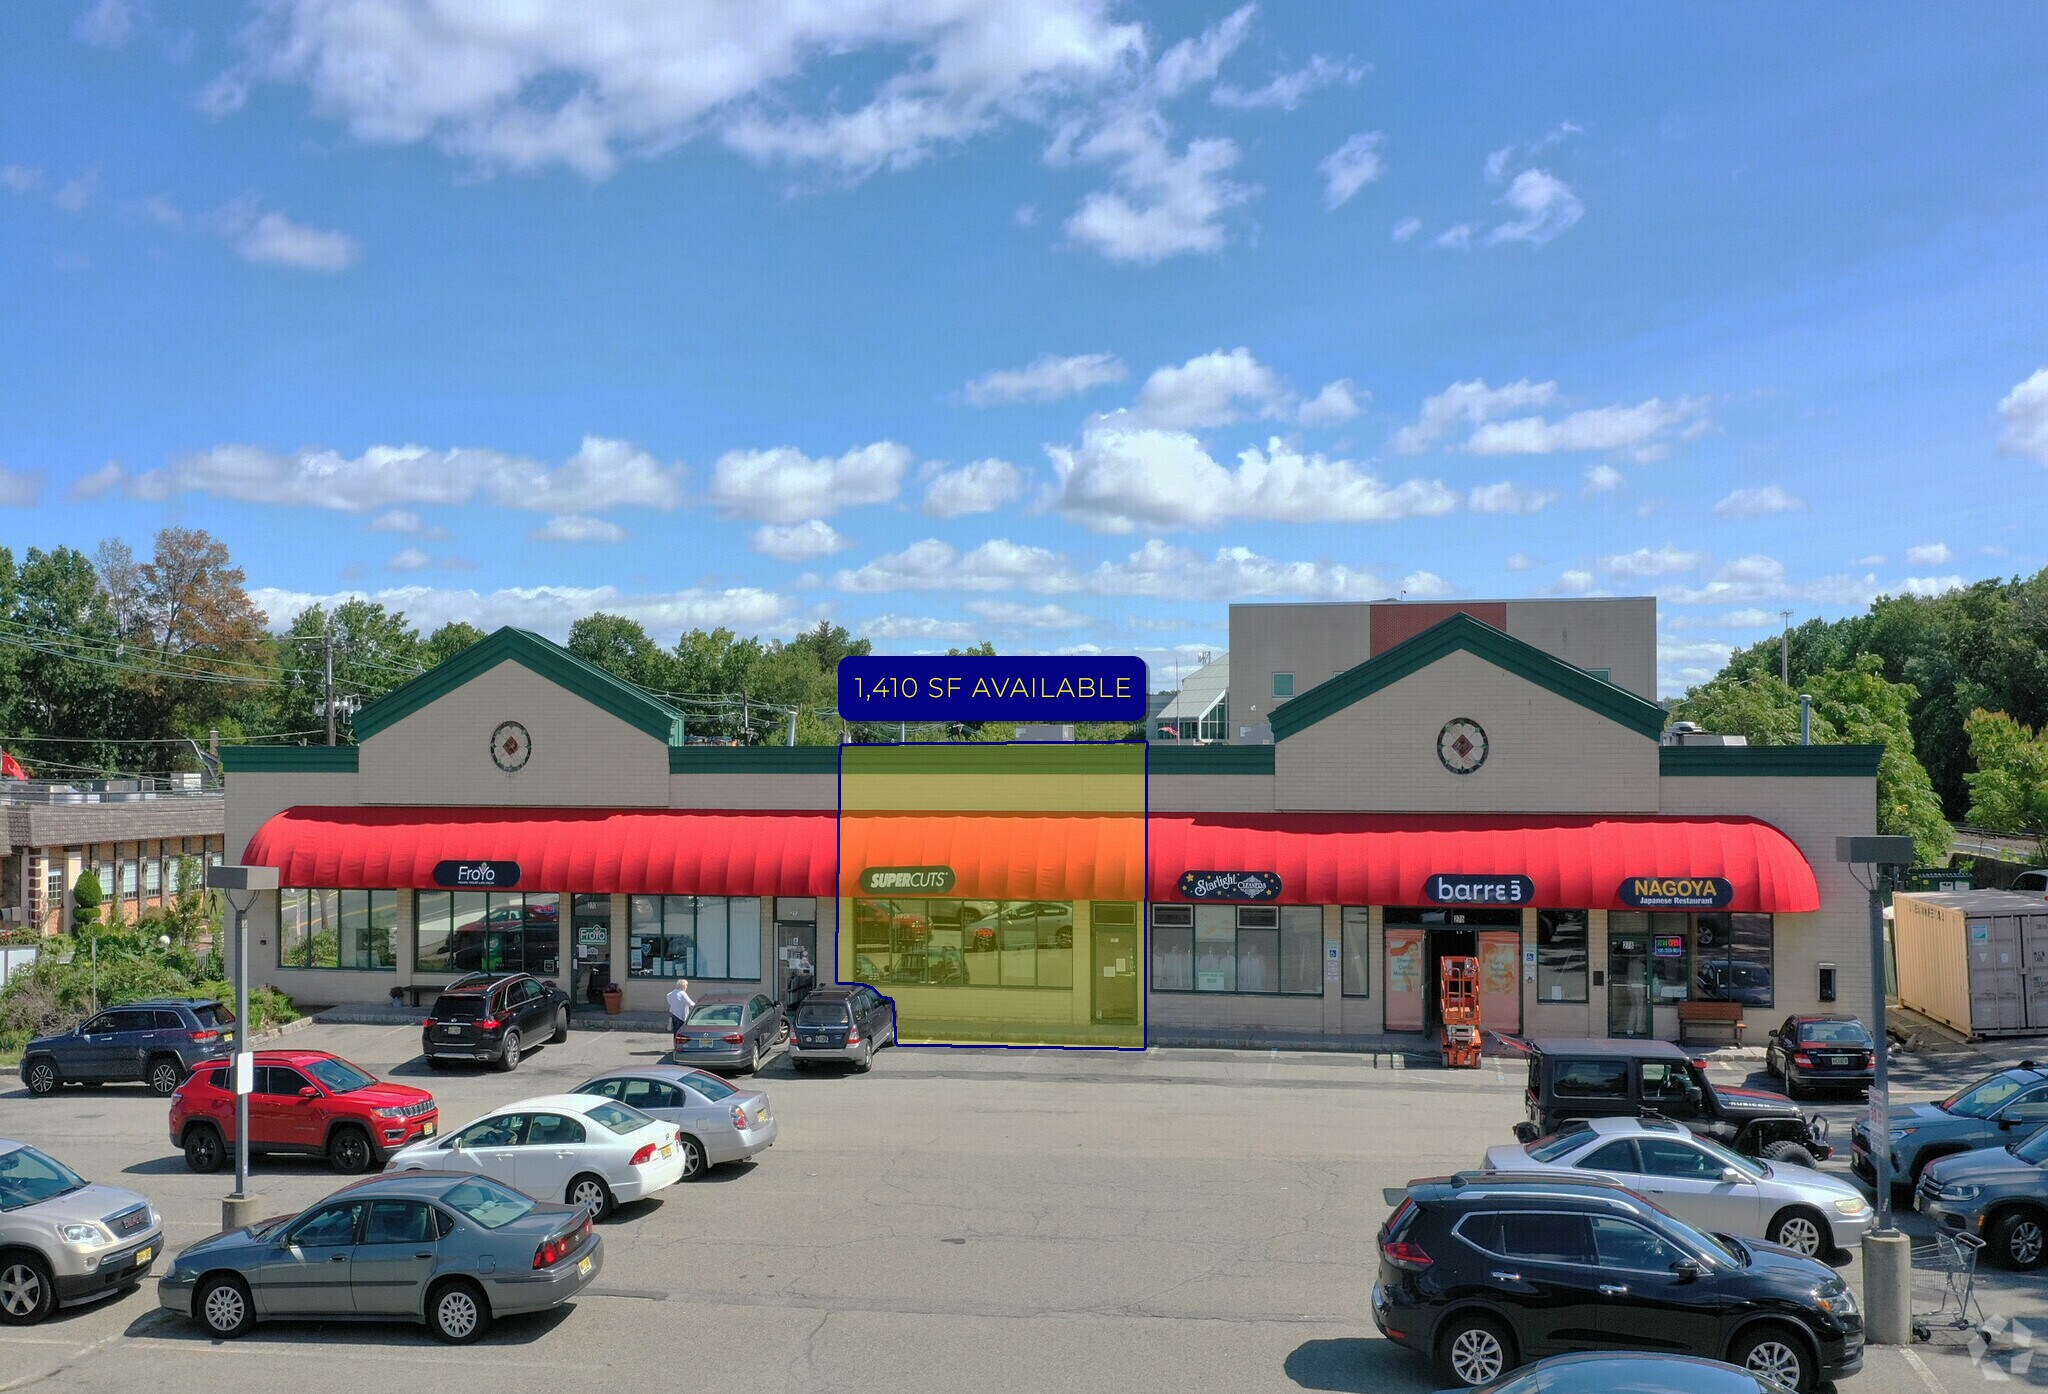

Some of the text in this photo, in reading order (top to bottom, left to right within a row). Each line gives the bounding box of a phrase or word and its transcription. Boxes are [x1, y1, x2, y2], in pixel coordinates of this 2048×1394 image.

[458, 865, 496, 881] FroYo
[870, 872, 947, 888] SUPERCUTS
[1194, 873, 1238, 897] Starlight
[1634, 879, 1718, 897] NAGOYA
[1639, 897, 1713, 906] Japanese Restaurant
[580, 928, 606, 940] FroYo
